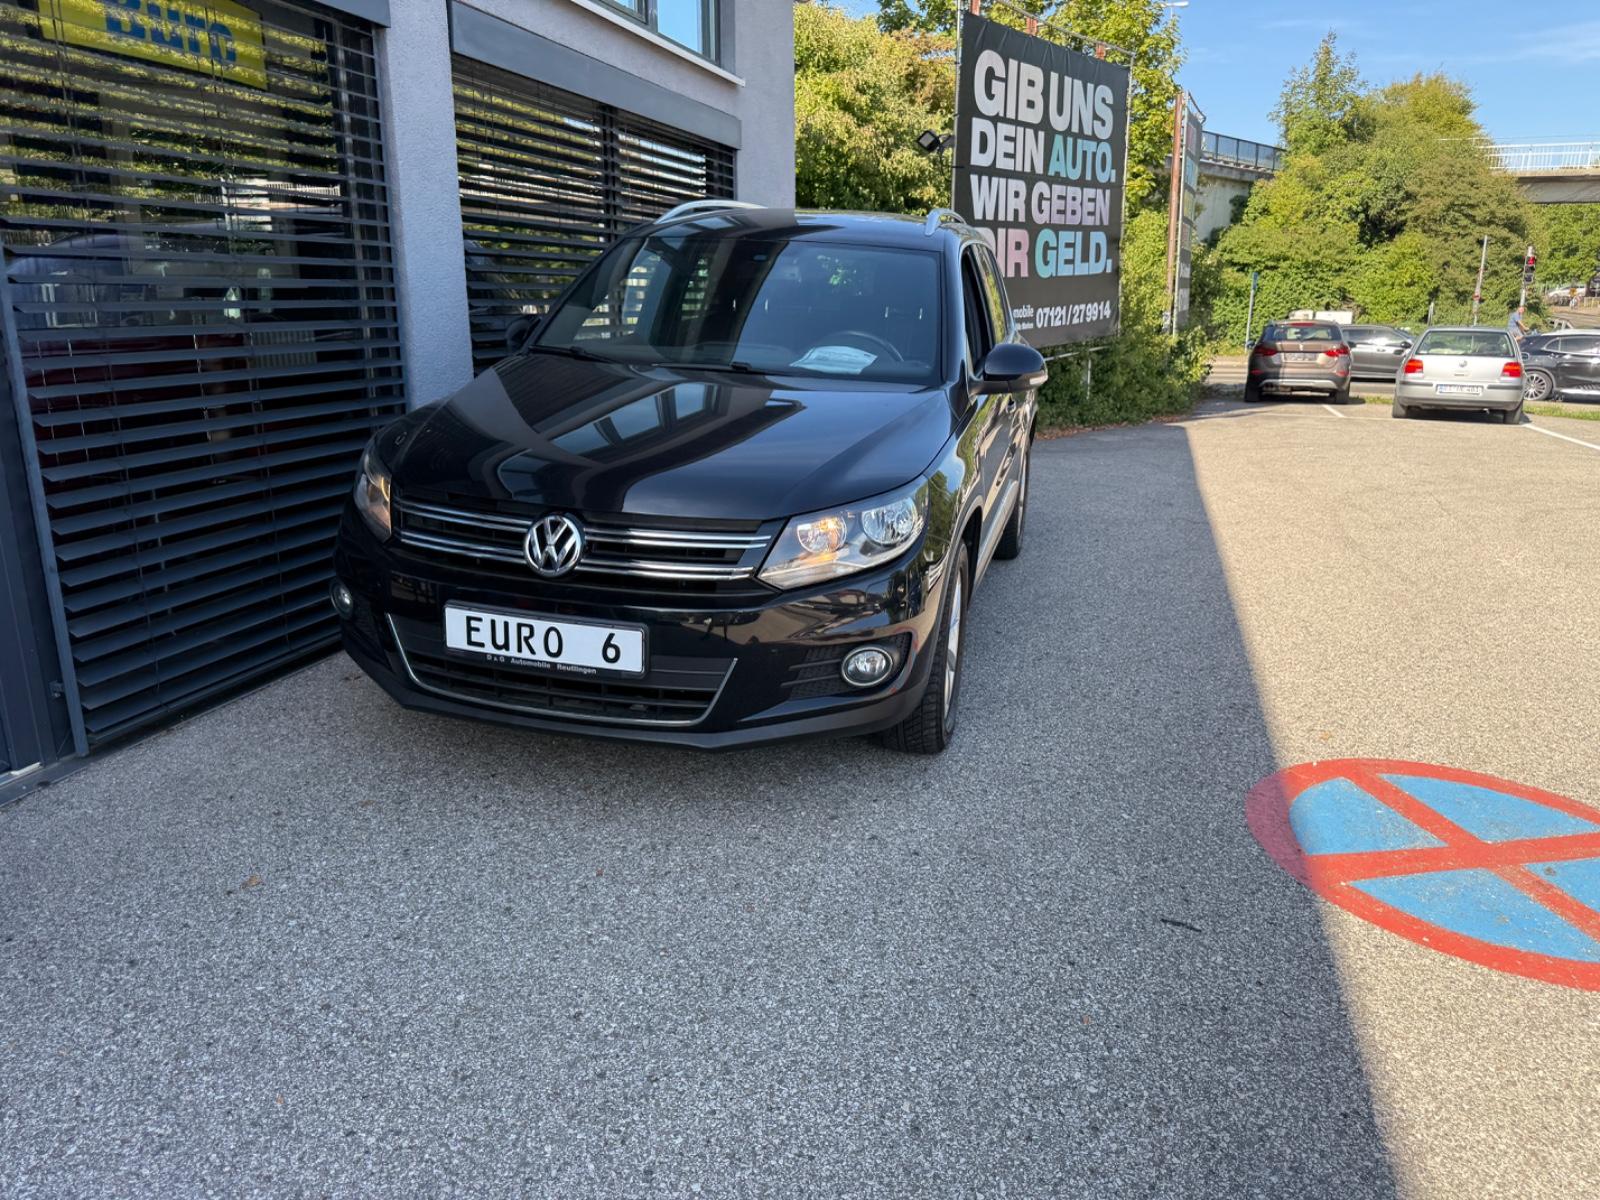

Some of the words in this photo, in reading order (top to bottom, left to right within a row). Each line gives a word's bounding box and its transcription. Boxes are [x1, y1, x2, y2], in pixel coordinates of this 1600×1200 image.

[974, 49, 1044, 124] GIB
[1049, 71, 1114, 140] UNS
[970, 117, 1045, 174] DEIN
[1048, 134, 1116, 183] AUTO.
[970, 174, 1027, 223] WIR
[1031, 181, 1110, 226] GEBEN
[1035, 228, 1112, 279] GELD.
[1036, 300, 1111, 329] 07121/279914
[466, 615, 563, 658] EURO
[602, 632, 621, 664] 6
[510, 657, 551, 669] Automobile
[556, 663, 597, 675] Reutlingen
